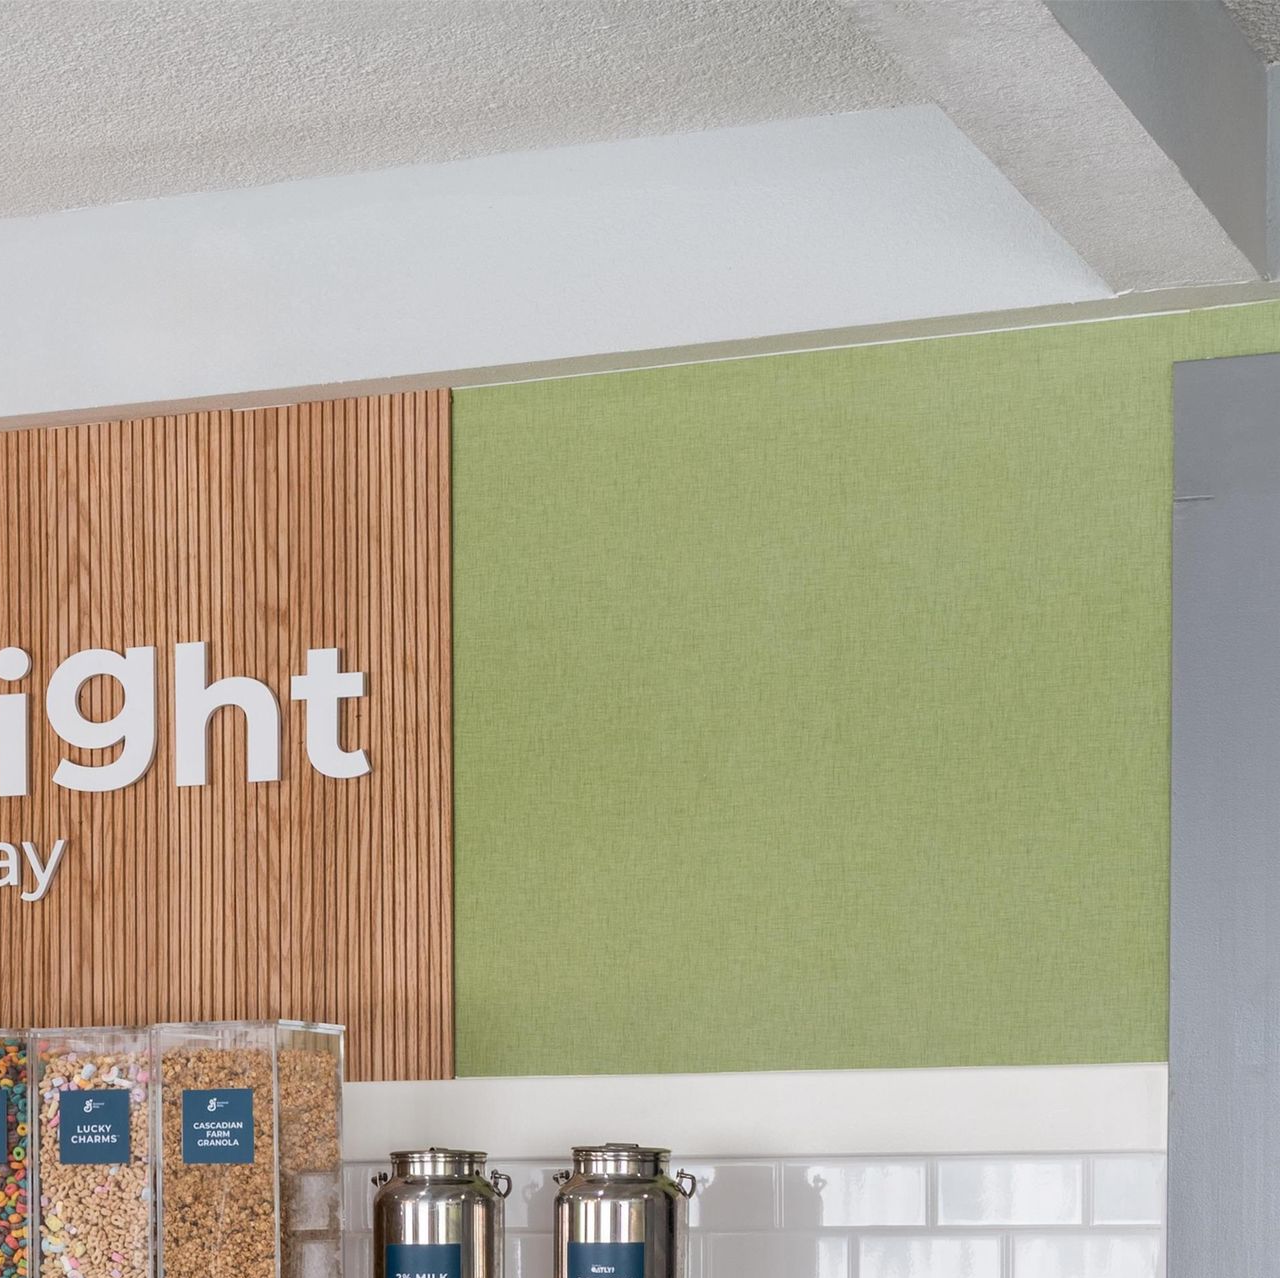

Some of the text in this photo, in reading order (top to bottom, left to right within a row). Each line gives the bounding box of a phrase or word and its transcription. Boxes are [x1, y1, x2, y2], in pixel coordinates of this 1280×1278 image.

[76, 1124, 112, 1134] LUCKY
[193, 1121, 243, 1130] CASCADIAN
[206, 1130, 231, 1138] FARM
[70, 1134, 118, 1144] CHARMS
[197, 1138, 240, 1147] GRANOLA
